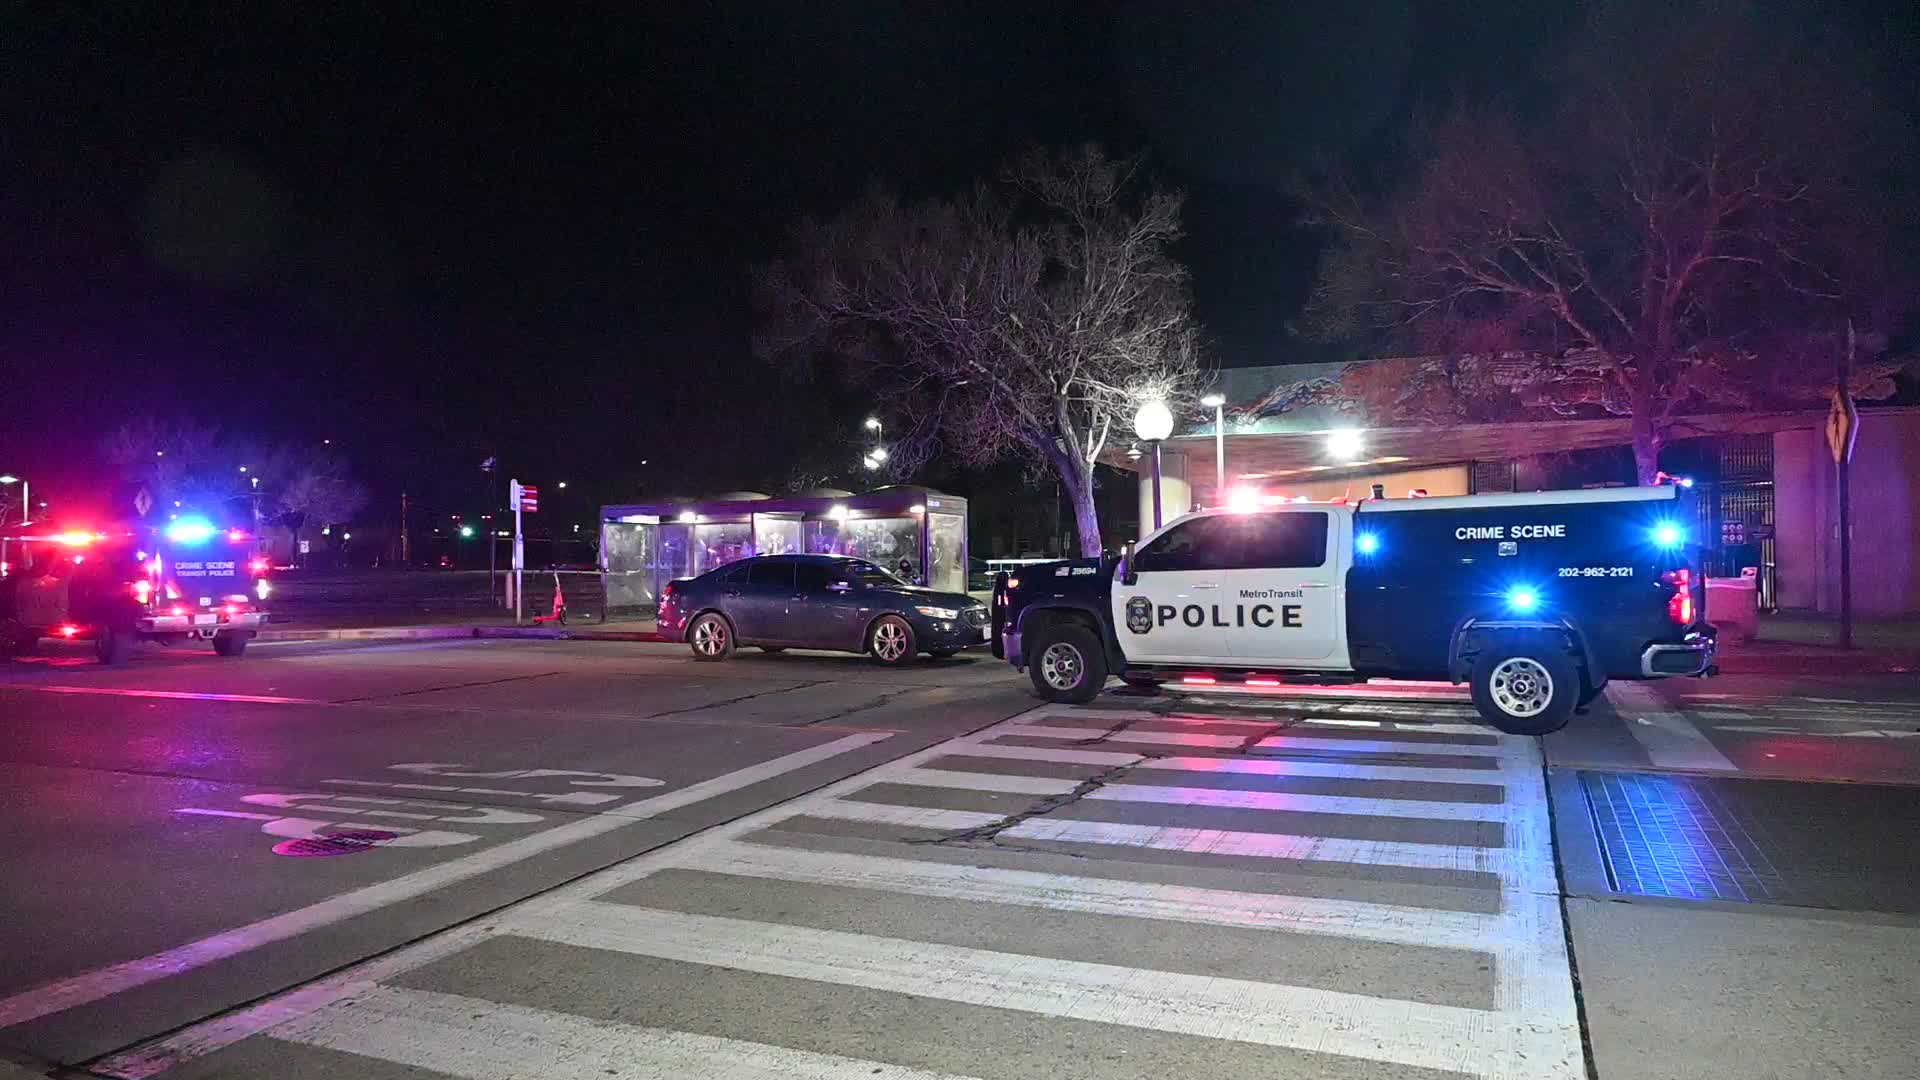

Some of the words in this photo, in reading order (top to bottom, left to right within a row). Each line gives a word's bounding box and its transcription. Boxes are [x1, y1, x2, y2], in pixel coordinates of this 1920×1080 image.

[1455, 526, 1504, 540] CRIME
[1510, 524, 1566, 539] SCENE
[1558, 567, 1633, 577] 202-962-2121
[1158, 604, 1303, 628] POLICE
